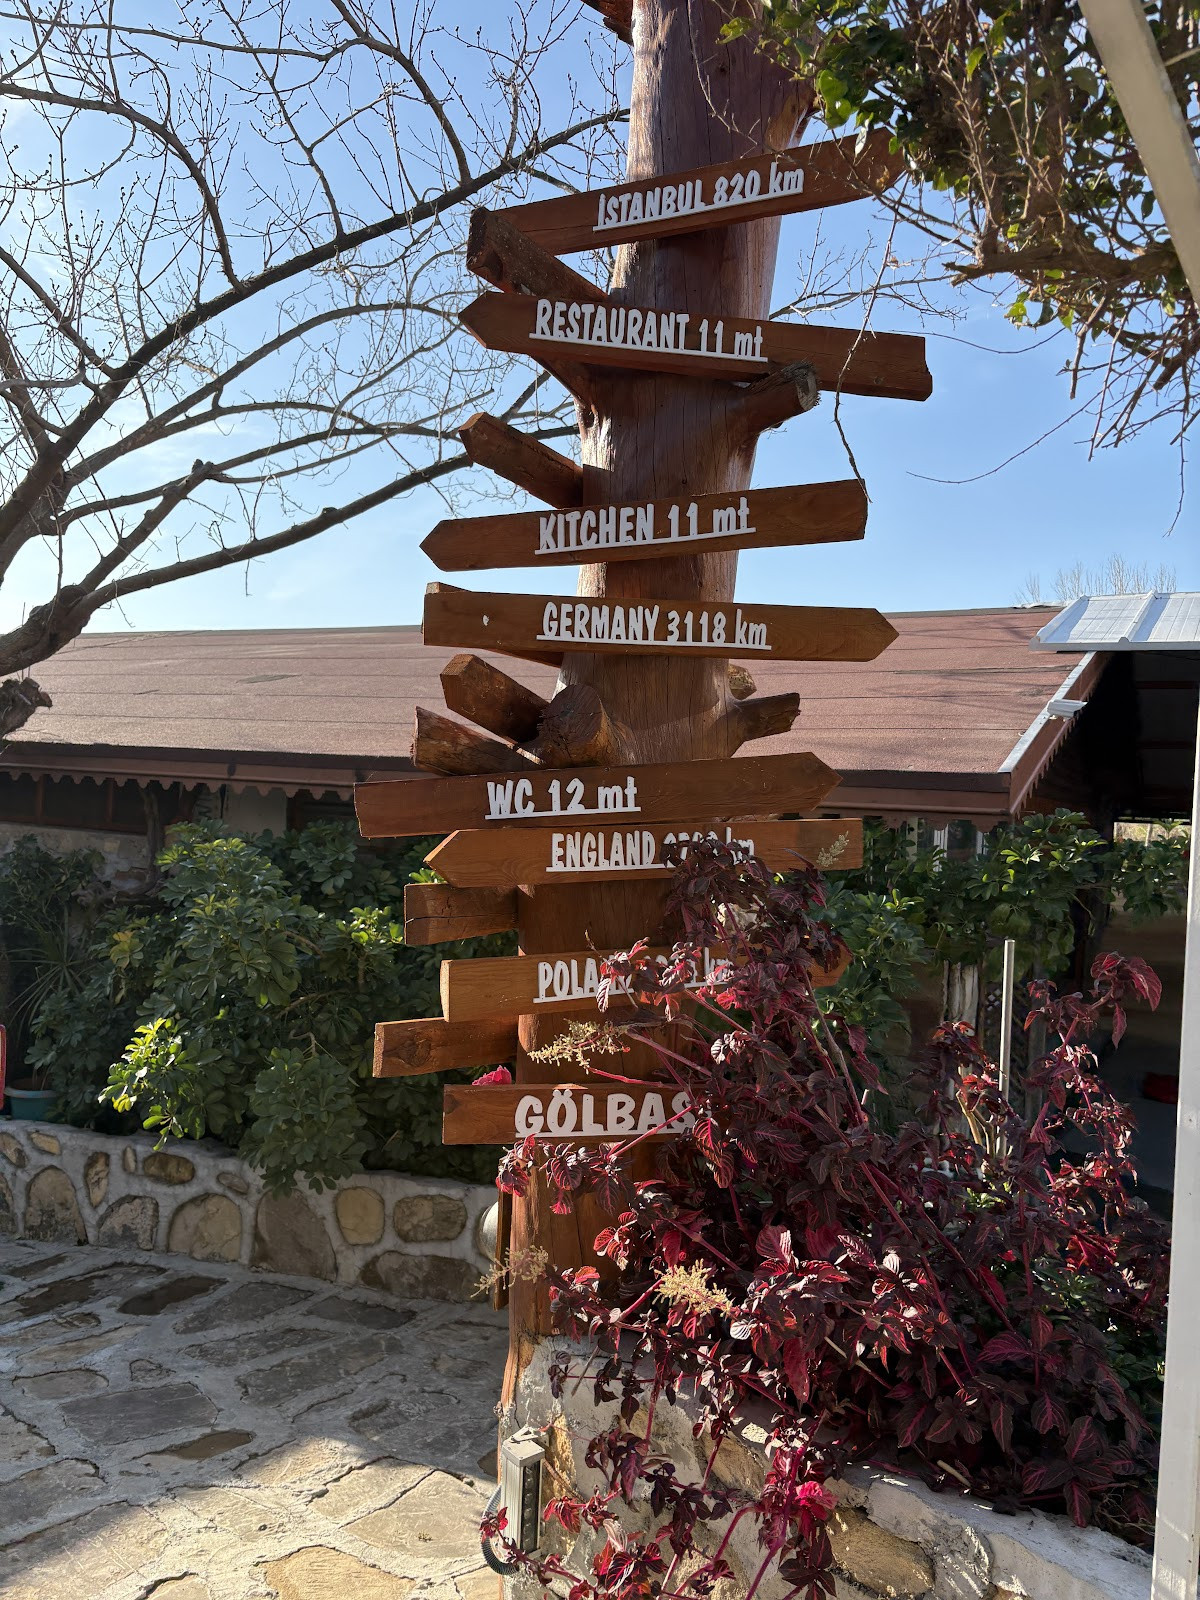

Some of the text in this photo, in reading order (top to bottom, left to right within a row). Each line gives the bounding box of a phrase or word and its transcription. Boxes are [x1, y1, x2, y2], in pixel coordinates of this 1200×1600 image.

[713, 169, 761, 207] 820
[769, 161, 805, 197] km
[534, 298, 764, 358] RESTAURANT 11 mt
[538, 496, 750, 551] KITCHEN 11 mt
[542, 601, 767, 648] GERMANY 3118 km
[486, 775, 638, 816] WC 12 mt
[551, 831, 656, 868] ENGLAND
[537, 956, 635, 999] POLA
[514, 1089, 712, 1134] GÖLBAS
